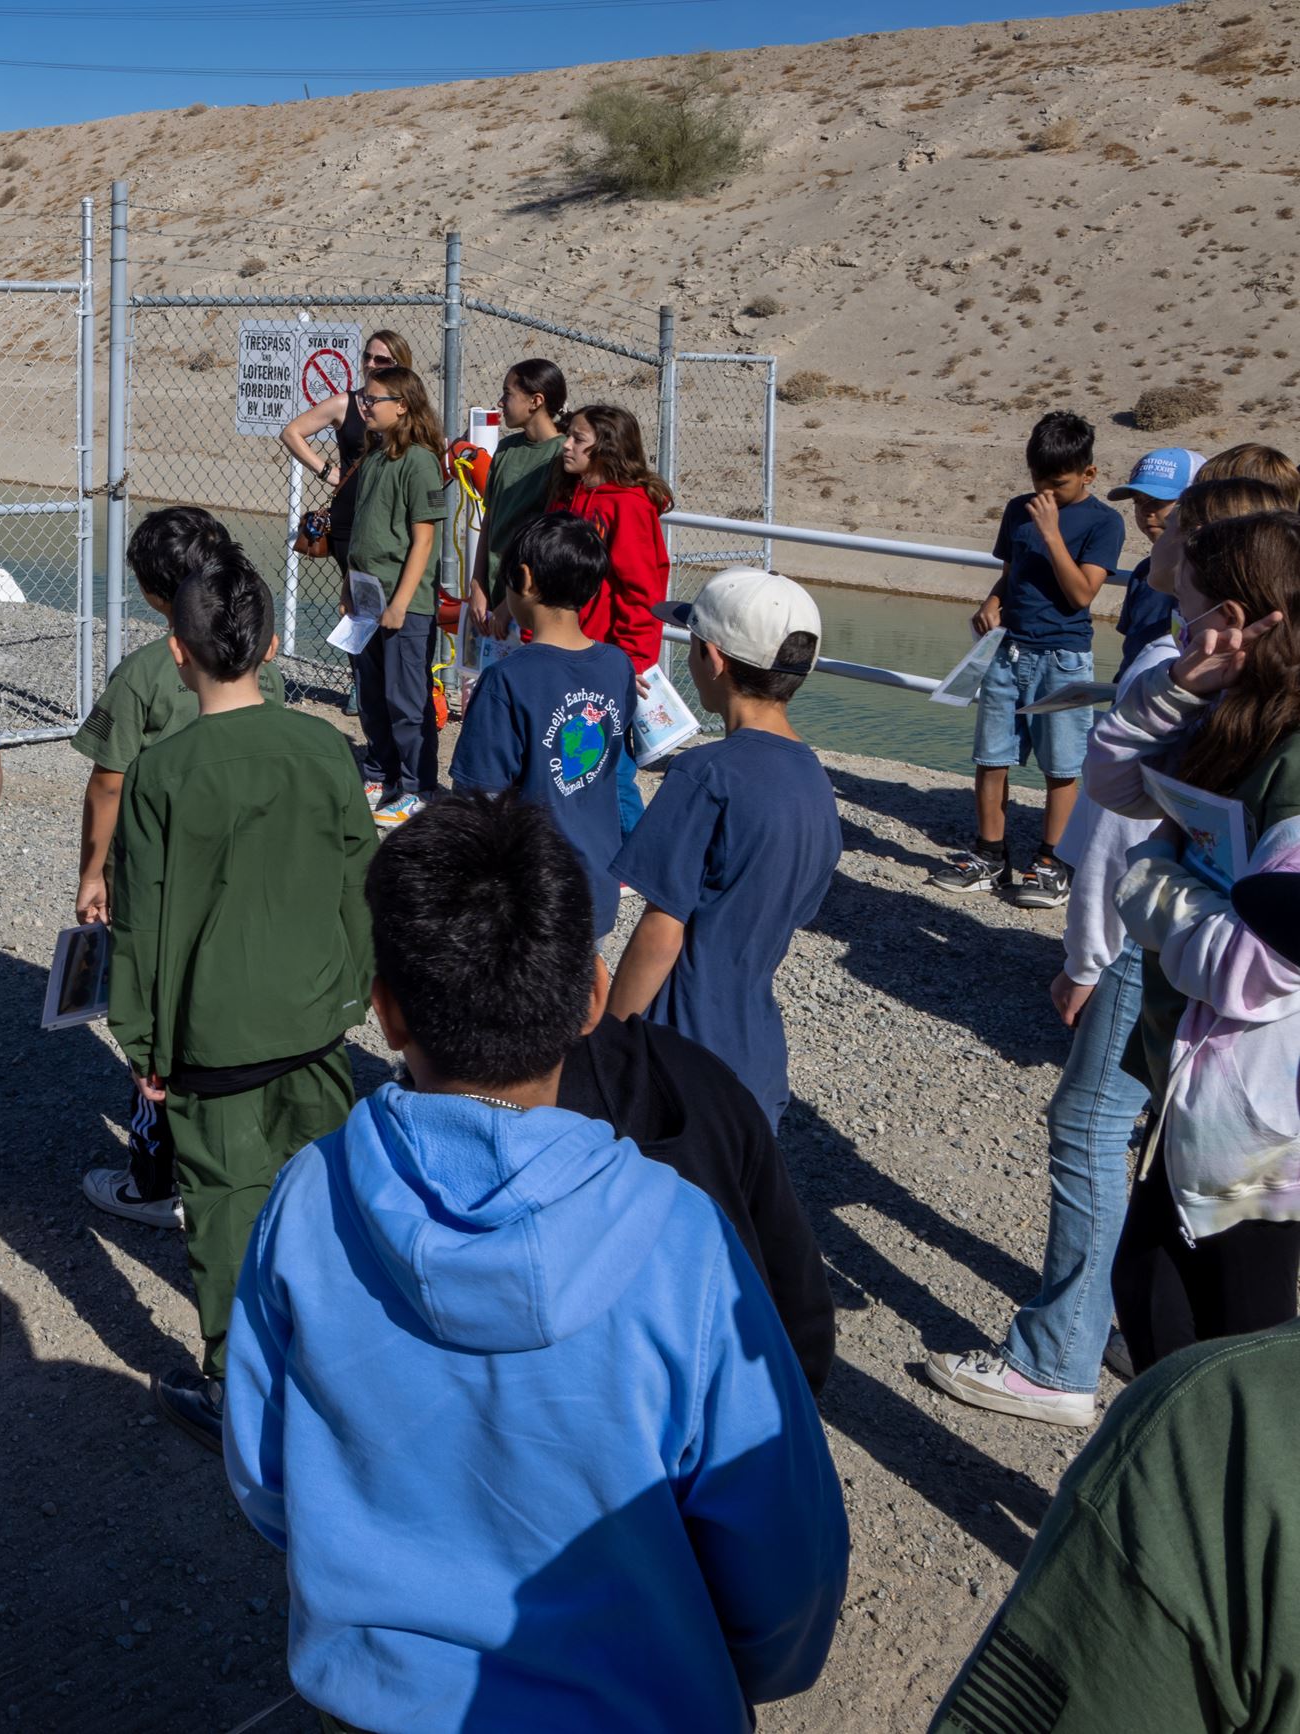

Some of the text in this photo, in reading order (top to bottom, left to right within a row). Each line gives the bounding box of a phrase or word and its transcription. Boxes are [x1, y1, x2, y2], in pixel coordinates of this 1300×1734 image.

[245, 335, 291, 351] TRESPASS
[308, 337, 349, 349] STAY OUT
[262, 354, 271, 362] AND
[243, 364, 290, 381] LOITERING
[240, 382, 291, 400] FORBIDDEN
[247, 401, 283, 418] BY LAW
[565, 688, 604, 707] Earhart
[604, 699, 623, 736] School
[549, 757, 562, 773] Of
